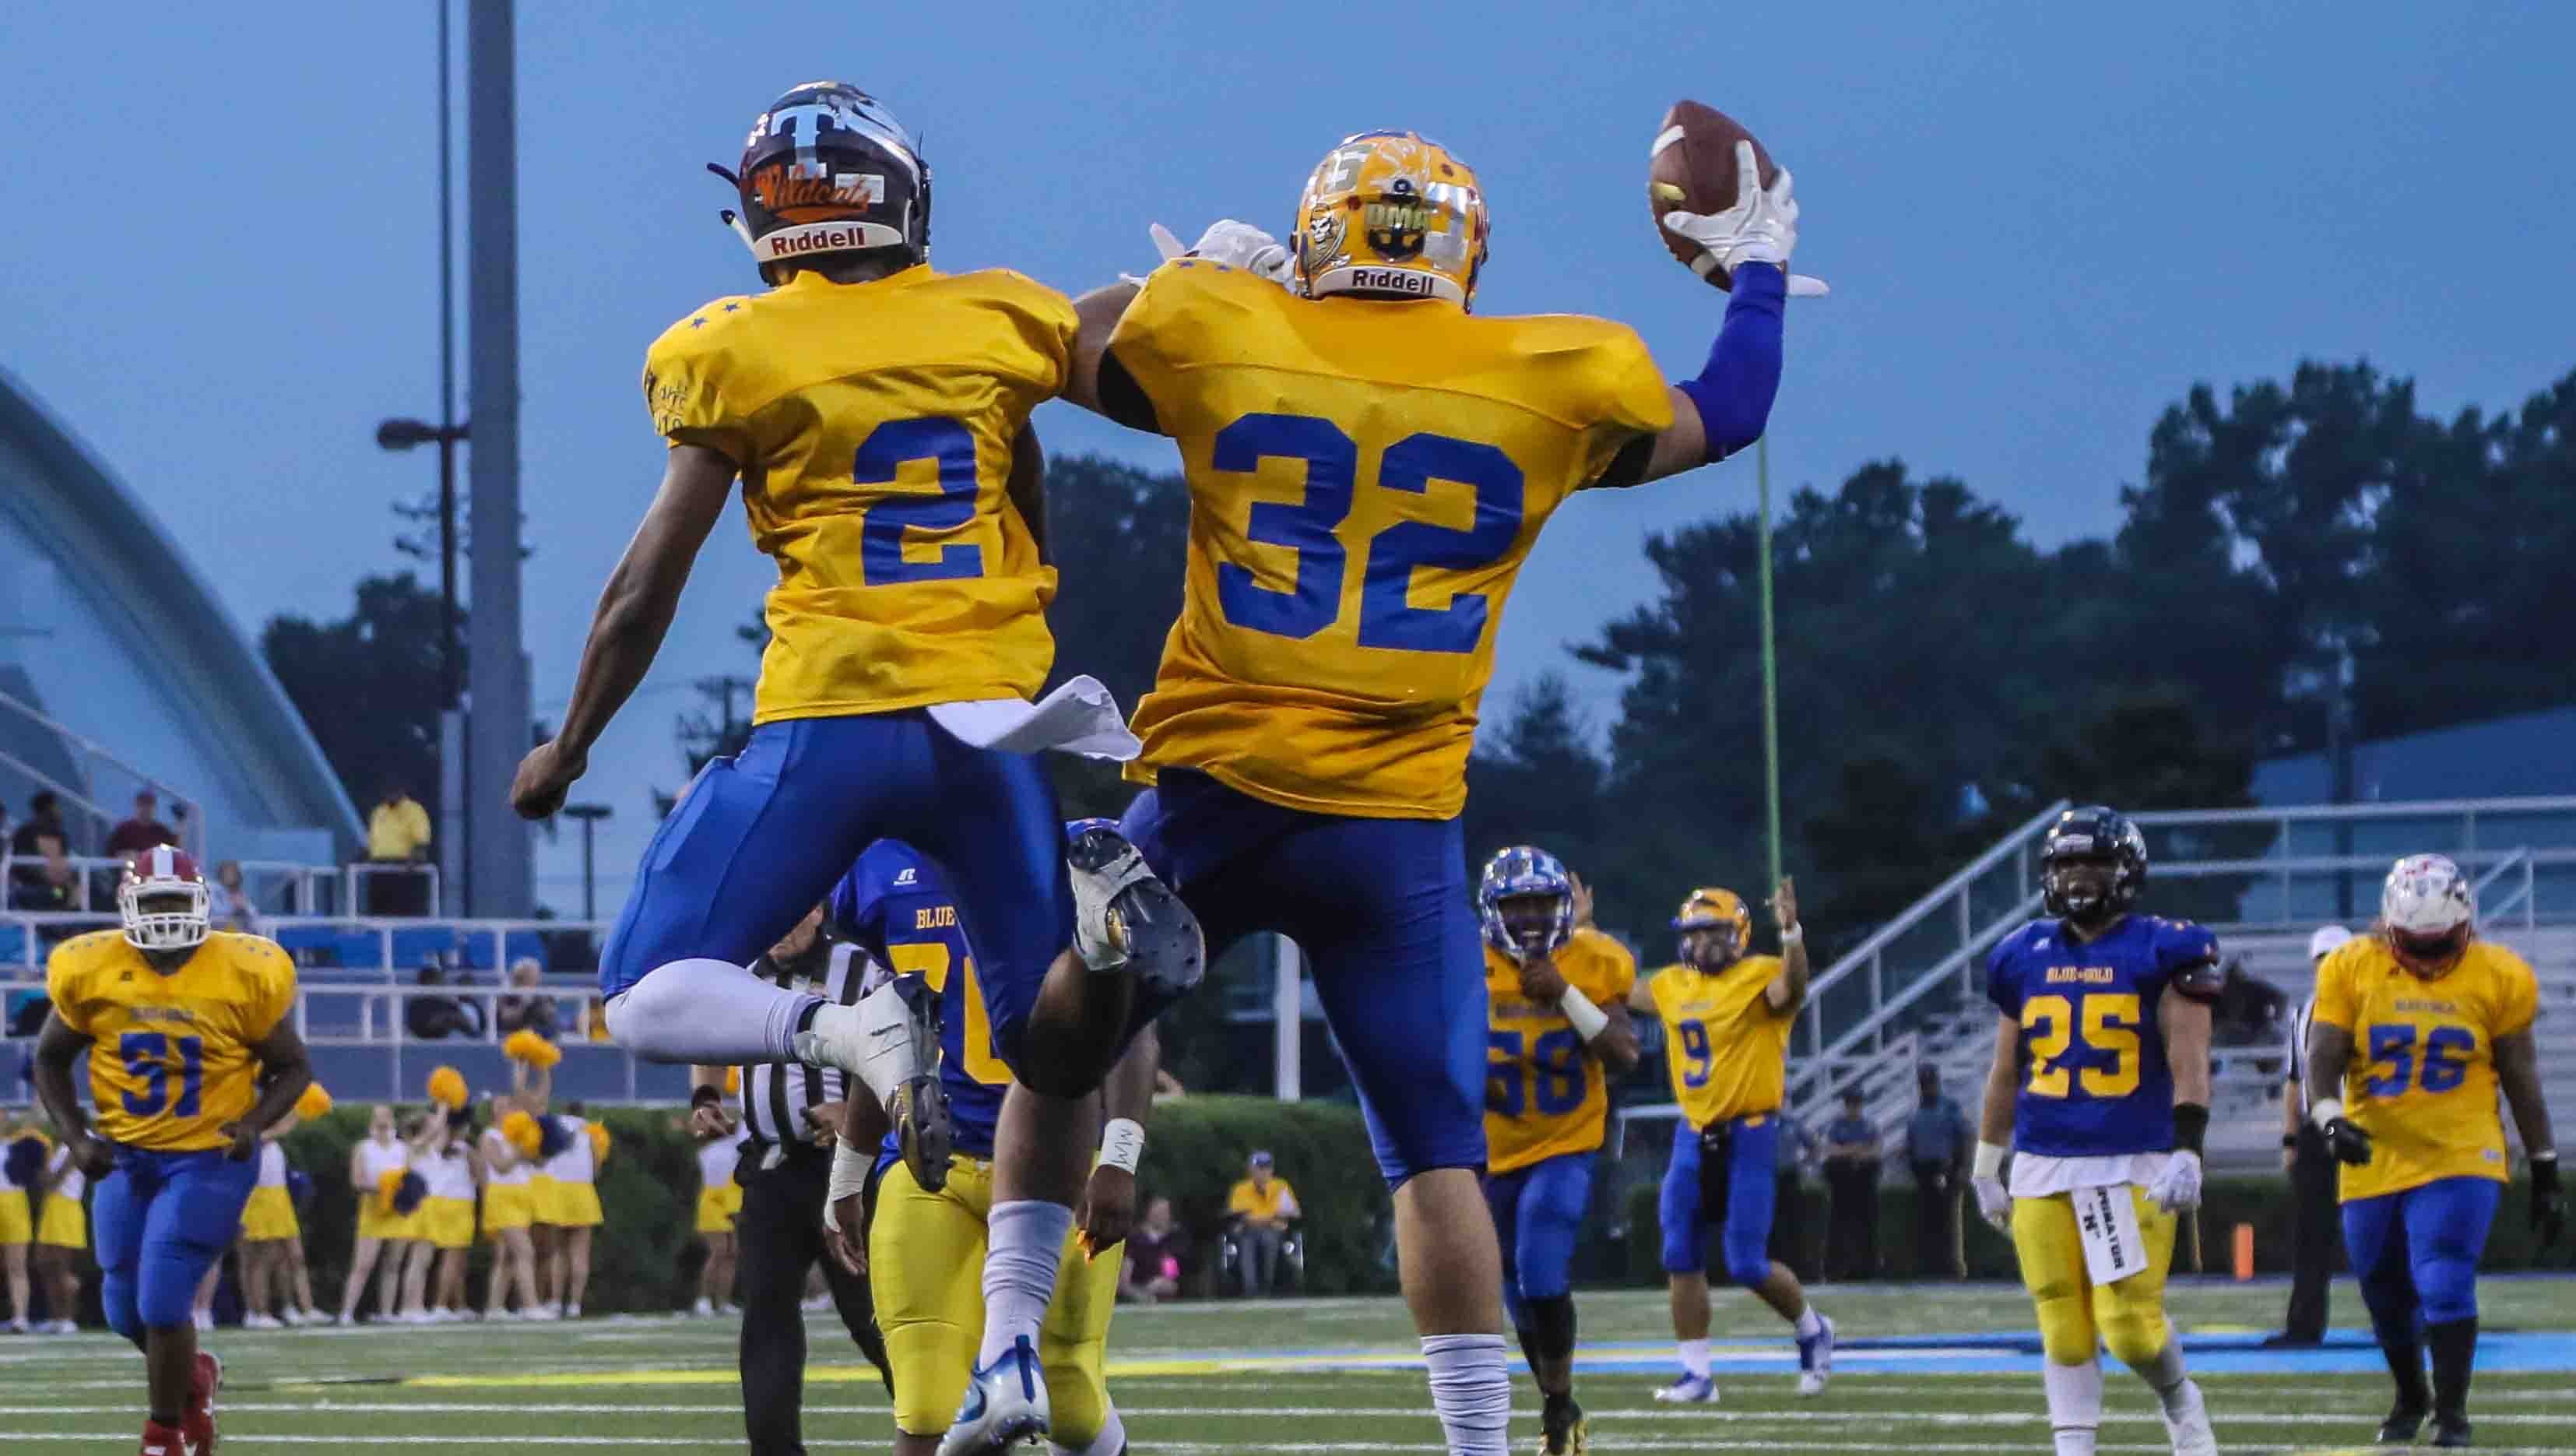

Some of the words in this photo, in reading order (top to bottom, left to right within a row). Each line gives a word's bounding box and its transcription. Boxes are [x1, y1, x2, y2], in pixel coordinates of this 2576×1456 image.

[771, 227, 866, 256] Riddell
[1351, 269, 1434, 294] Riddell
[853, 416, 984, 586] 2
[1211, 412, 1525, 655] 32
[915, 906, 956, 929] BLUE
[1680, 1018, 1713, 1088] 9
[2021, 992, 2142, 1099] 25
[2367, 1024, 2476, 1097] 56
